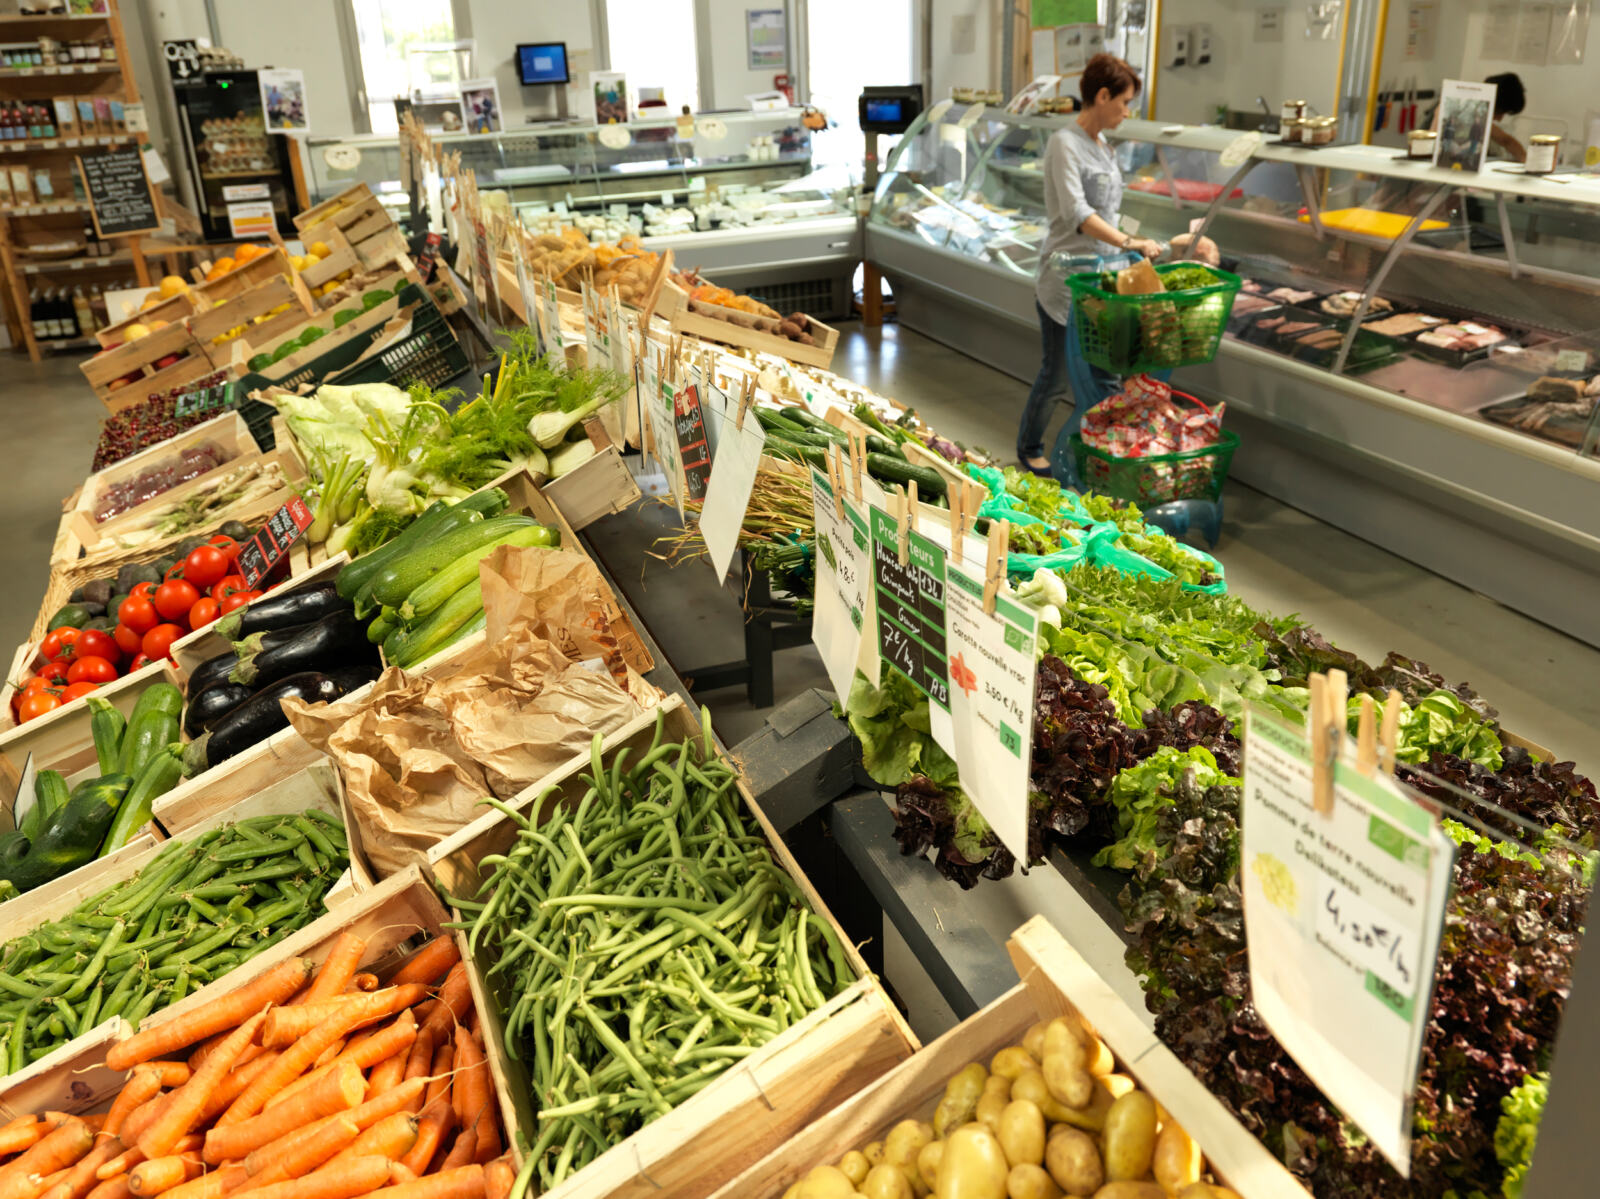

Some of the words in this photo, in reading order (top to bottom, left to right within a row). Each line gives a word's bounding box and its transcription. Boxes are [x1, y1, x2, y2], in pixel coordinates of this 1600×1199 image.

[878, 517, 935, 567] Prodteurs
[952, 621, 978, 649] Carotte
[978, 644, 1007, 672] nouvelle
[1009, 667, 1026, 686] vrac
[930, 677, 947, 703] AB
[1254, 787, 1297, 828] Pomme
[1301, 822, 1316, 840] de
[1319, 835, 1353, 865] terre
[1355, 860, 1416, 908] nouvelle
